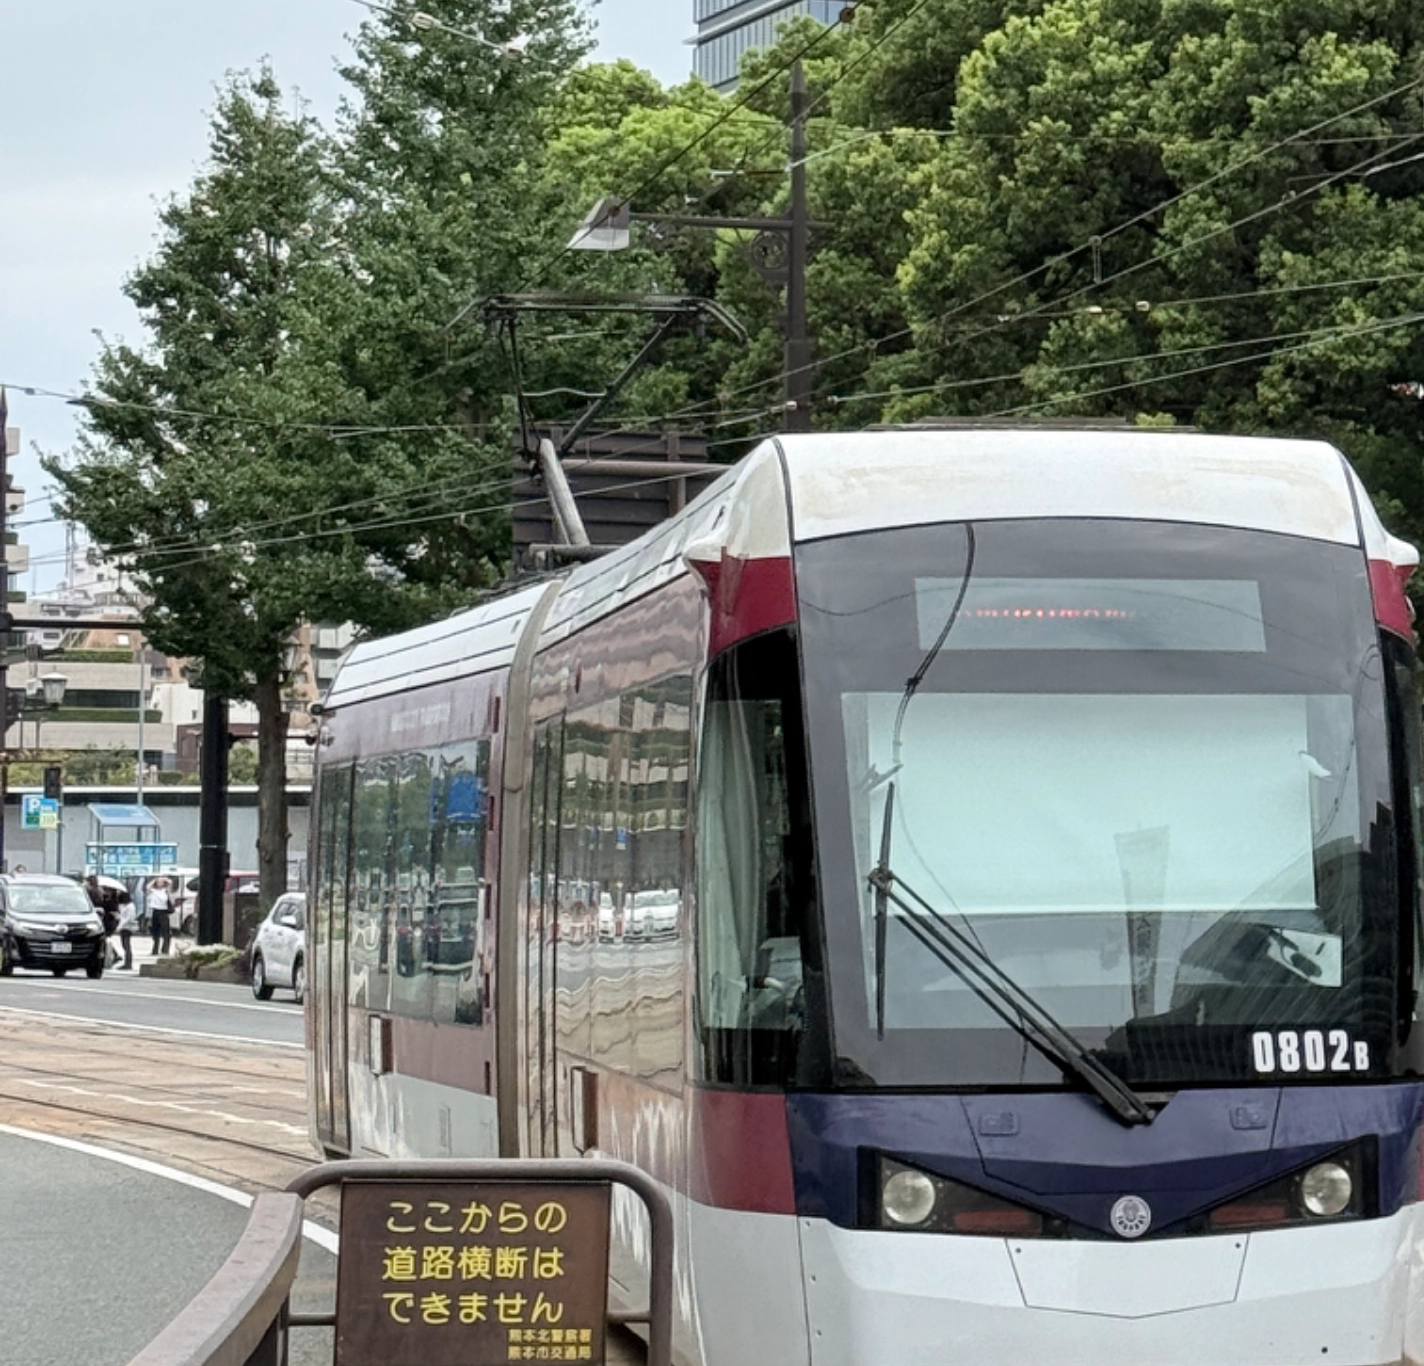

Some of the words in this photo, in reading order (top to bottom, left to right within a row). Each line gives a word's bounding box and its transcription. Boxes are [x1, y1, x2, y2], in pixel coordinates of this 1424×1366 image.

[387, 1201, 567, 1233] ここからの
[382, 1246, 565, 1280] 道路横断は
[382, 1291, 564, 1324] できません
